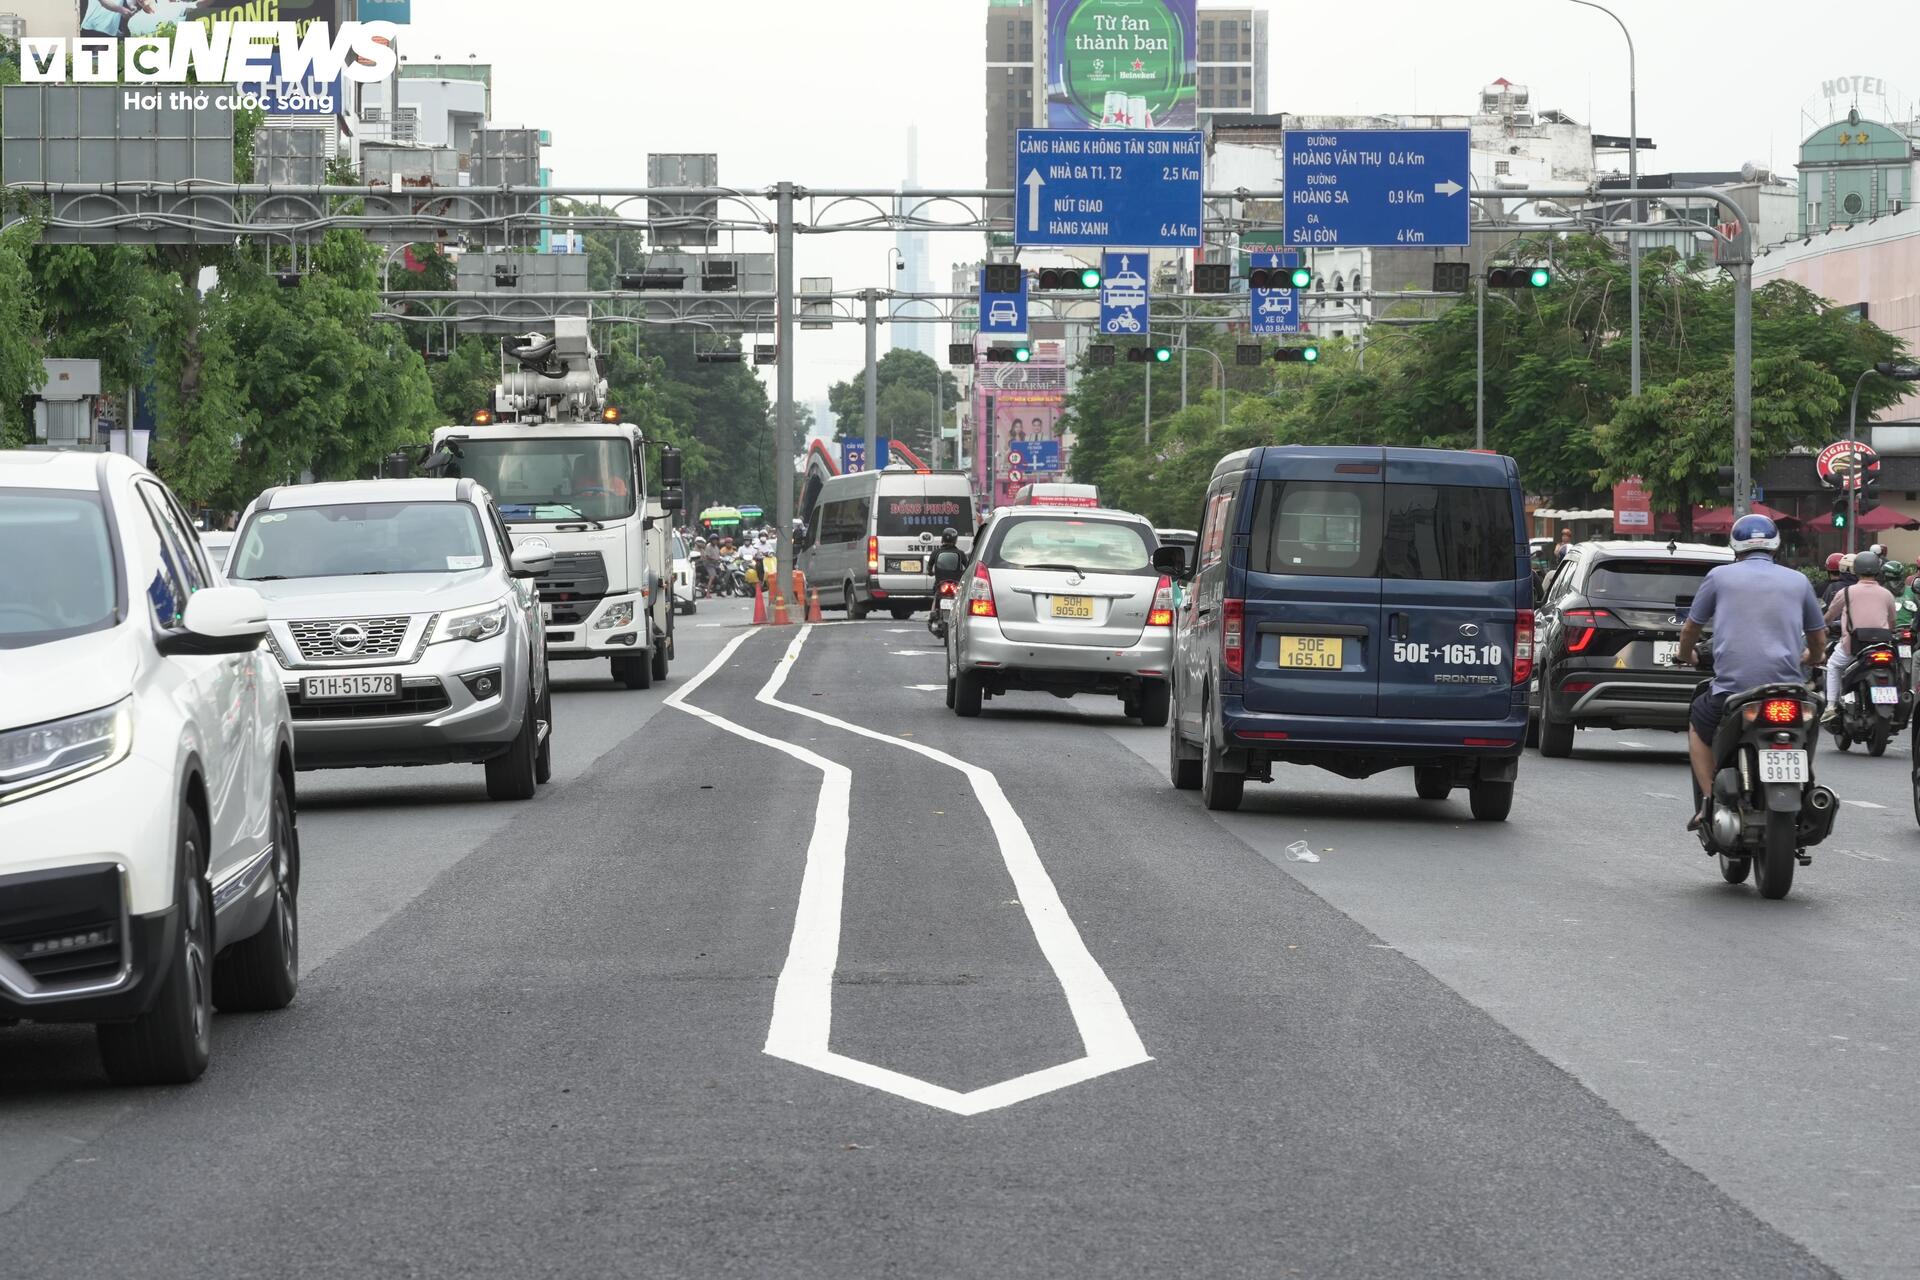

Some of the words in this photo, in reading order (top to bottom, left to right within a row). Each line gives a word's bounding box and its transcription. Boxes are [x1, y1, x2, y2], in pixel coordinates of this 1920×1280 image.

[1093, 14, 1117, 31] Từ
[1120, 15, 1150, 31] fan
[1075, 34, 1129, 50] thành
[1134, 34, 1169, 54] bạn
[1821, 75, 1886, 98] HOTEL
[1020, 135, 1048, 154] CẢNG
[1052, 136, 1080, 154] HÀNG
[1083, 137, 1121, 154] KHÔNG
[1124, 138, 1144, 154] TÂN
[1147, 140, 1169, 154] SƠN
[1172, 135, 1200, 154] NHẤT
[1307, 134, 1337, 146] ĐƯỜNG
[1293, 149, 1331, 165] HOÀNG
[1334, 149, 1357, 165] VĂN
[1360, 151, 1382, 168] THỤ
[1407, 152, 1425, 165] Km
[1050, 161, 1071, 179] NHÀ
[1074, 166, 1088, 179] GA
[1109, 166, 1122, 179] T2
[1182, 167, 1199, 181] Km
[1307, 173, 1337, 185] ĐƯỜNG
[1293, 187, 1331, 203] HOÀNG
[1334, 190, 1349, 203] SA
[1407, 190, 1425, 203] Km
[1054, 195, 1075, 212] NÚT
[1078, 199, 1103, 212] GIAO
[1050, 217, 1078, 234] HÀNG
[1081, 221, 1108, 235] XANH
[1180, 224, 1197, 237] Km
[1307, 214, 1319, 224] GA
[1293, 226, 1311, 242] SÀI
[1314, 226, 1337, 242] GÒN
[1396, 229, 1404, 242] 4
[1407, 229, 1424, 242] Km
[1064, 596, 1082, 607] 50H
[1056, 606, 1089, 617] 905.03
[1298, 638, 1325, 652] 50E
[1288, 652, 1335, 667] 165.10
[309, 676, 393, 696] 51H-515.78
[1434, 674, 1498, 684] FRONTIER
[1766, 752, 1800, 766] 55-P6
[1767, 766, 1801, 780] 9819
